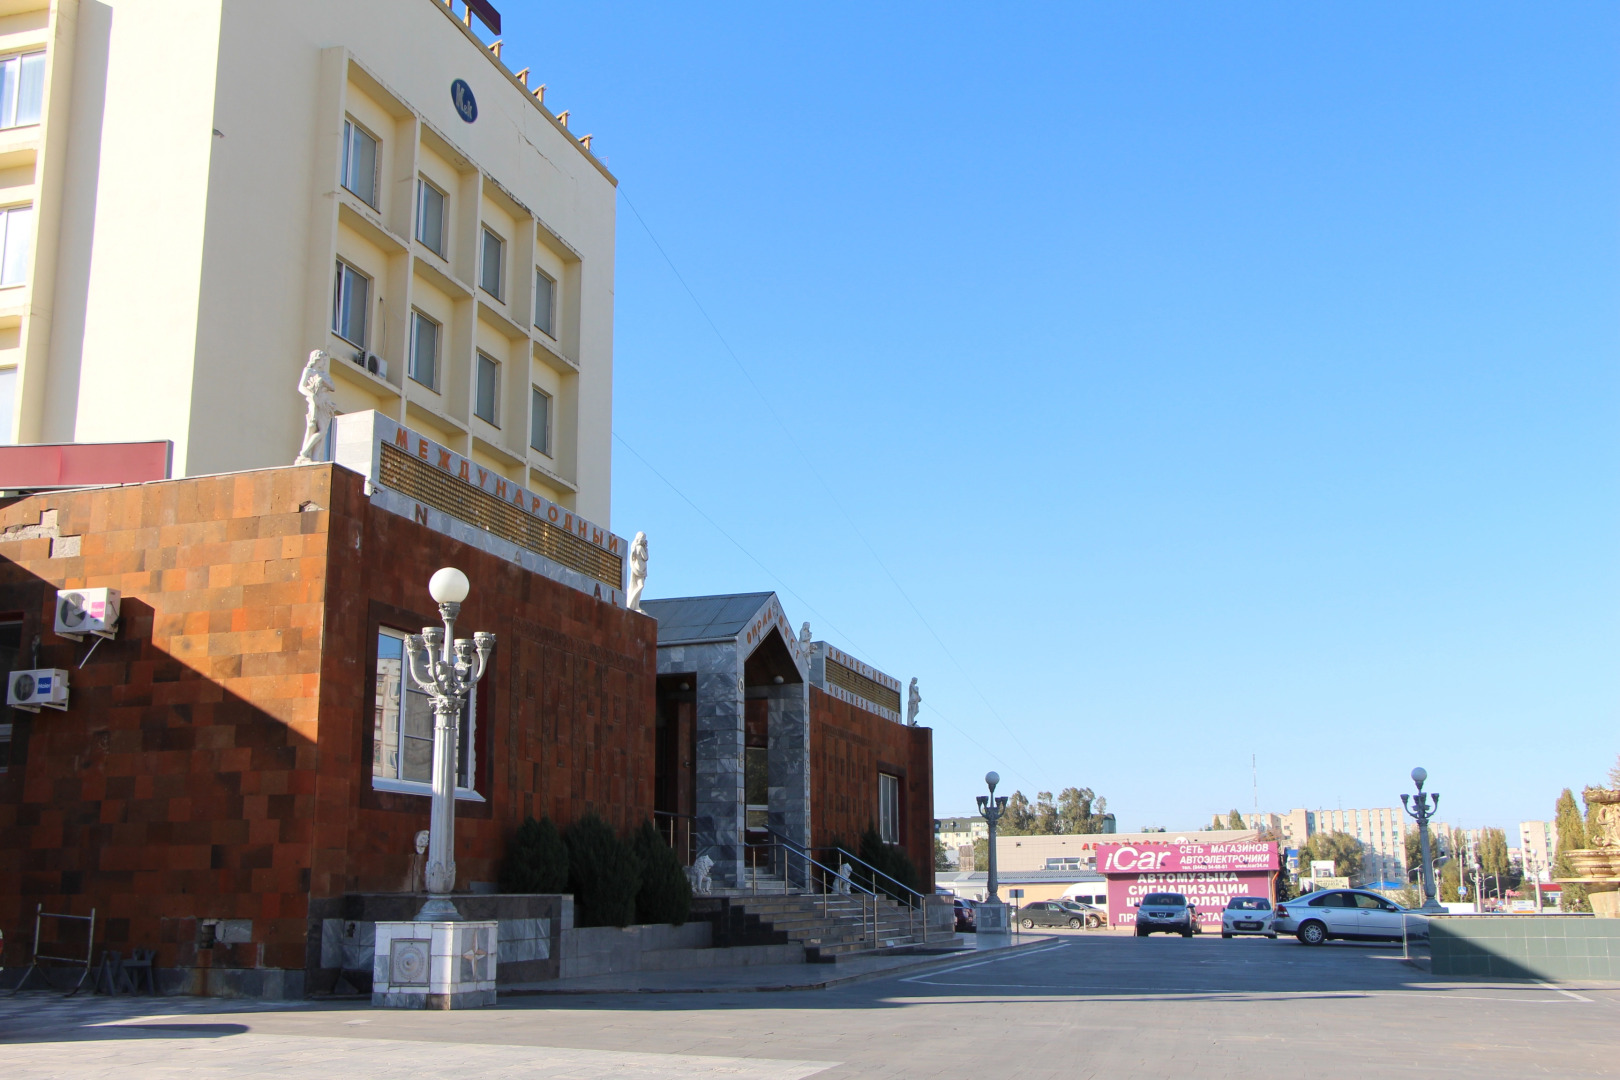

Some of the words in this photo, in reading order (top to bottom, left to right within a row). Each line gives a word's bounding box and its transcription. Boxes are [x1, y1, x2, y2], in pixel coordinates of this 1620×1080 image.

[395, 427, 618, 551] МЕЖДУНАРОДНЫЙ
[1180, 845, 1204, 854] СЕТЬ
[1211, 843, 1269, 853] МАГАЗИНОВ
[1104, 847, 1171, 870] iCar
[1180, 854, 1270, 864] АВТОЭЛЕКТРОНИКИ
[1137, 872, 1239, 883] АВТОМУЗЫКА
[1128, 884, 1249, 895] СИГНАЛИЗАЦИИ
